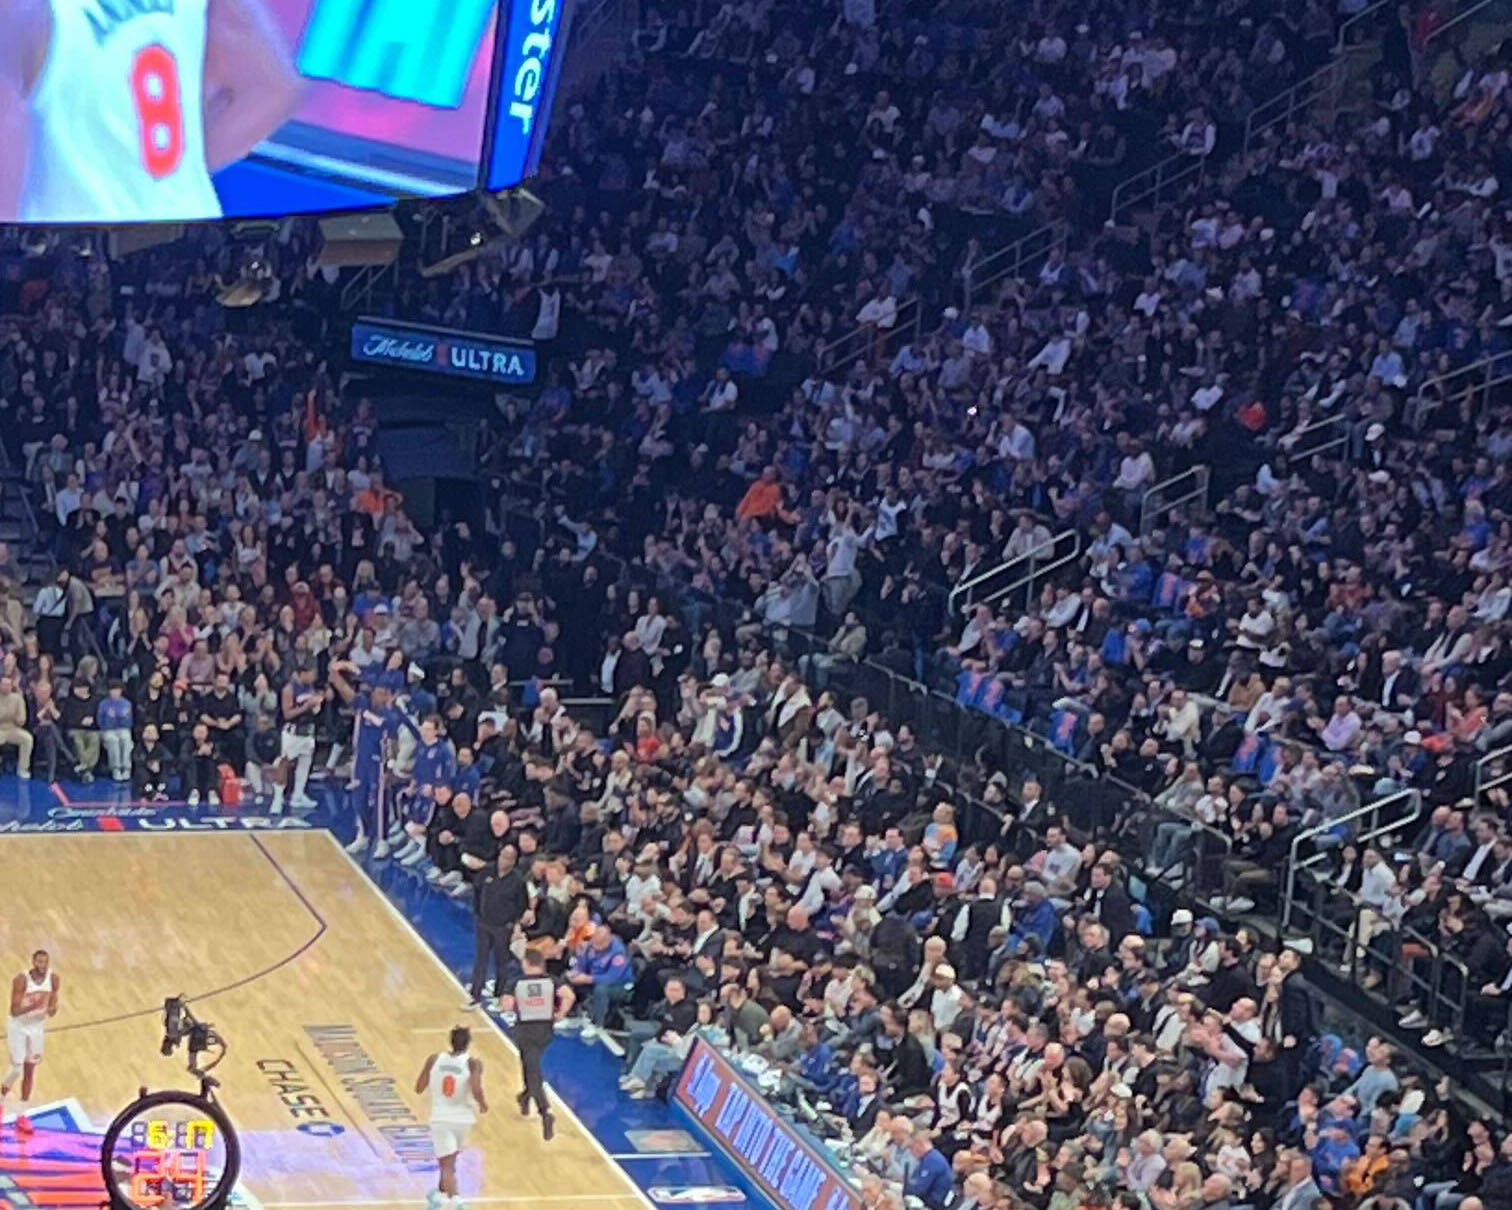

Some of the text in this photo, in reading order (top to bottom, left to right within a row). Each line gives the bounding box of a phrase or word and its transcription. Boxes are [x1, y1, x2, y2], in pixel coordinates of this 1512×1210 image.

[129, 43, 185, 178] 8
[451, 346, 525, 376] ULTRA
[138, 816, 313, 830] ULTRA
[256, 1059, 330, 1119] CHASE
